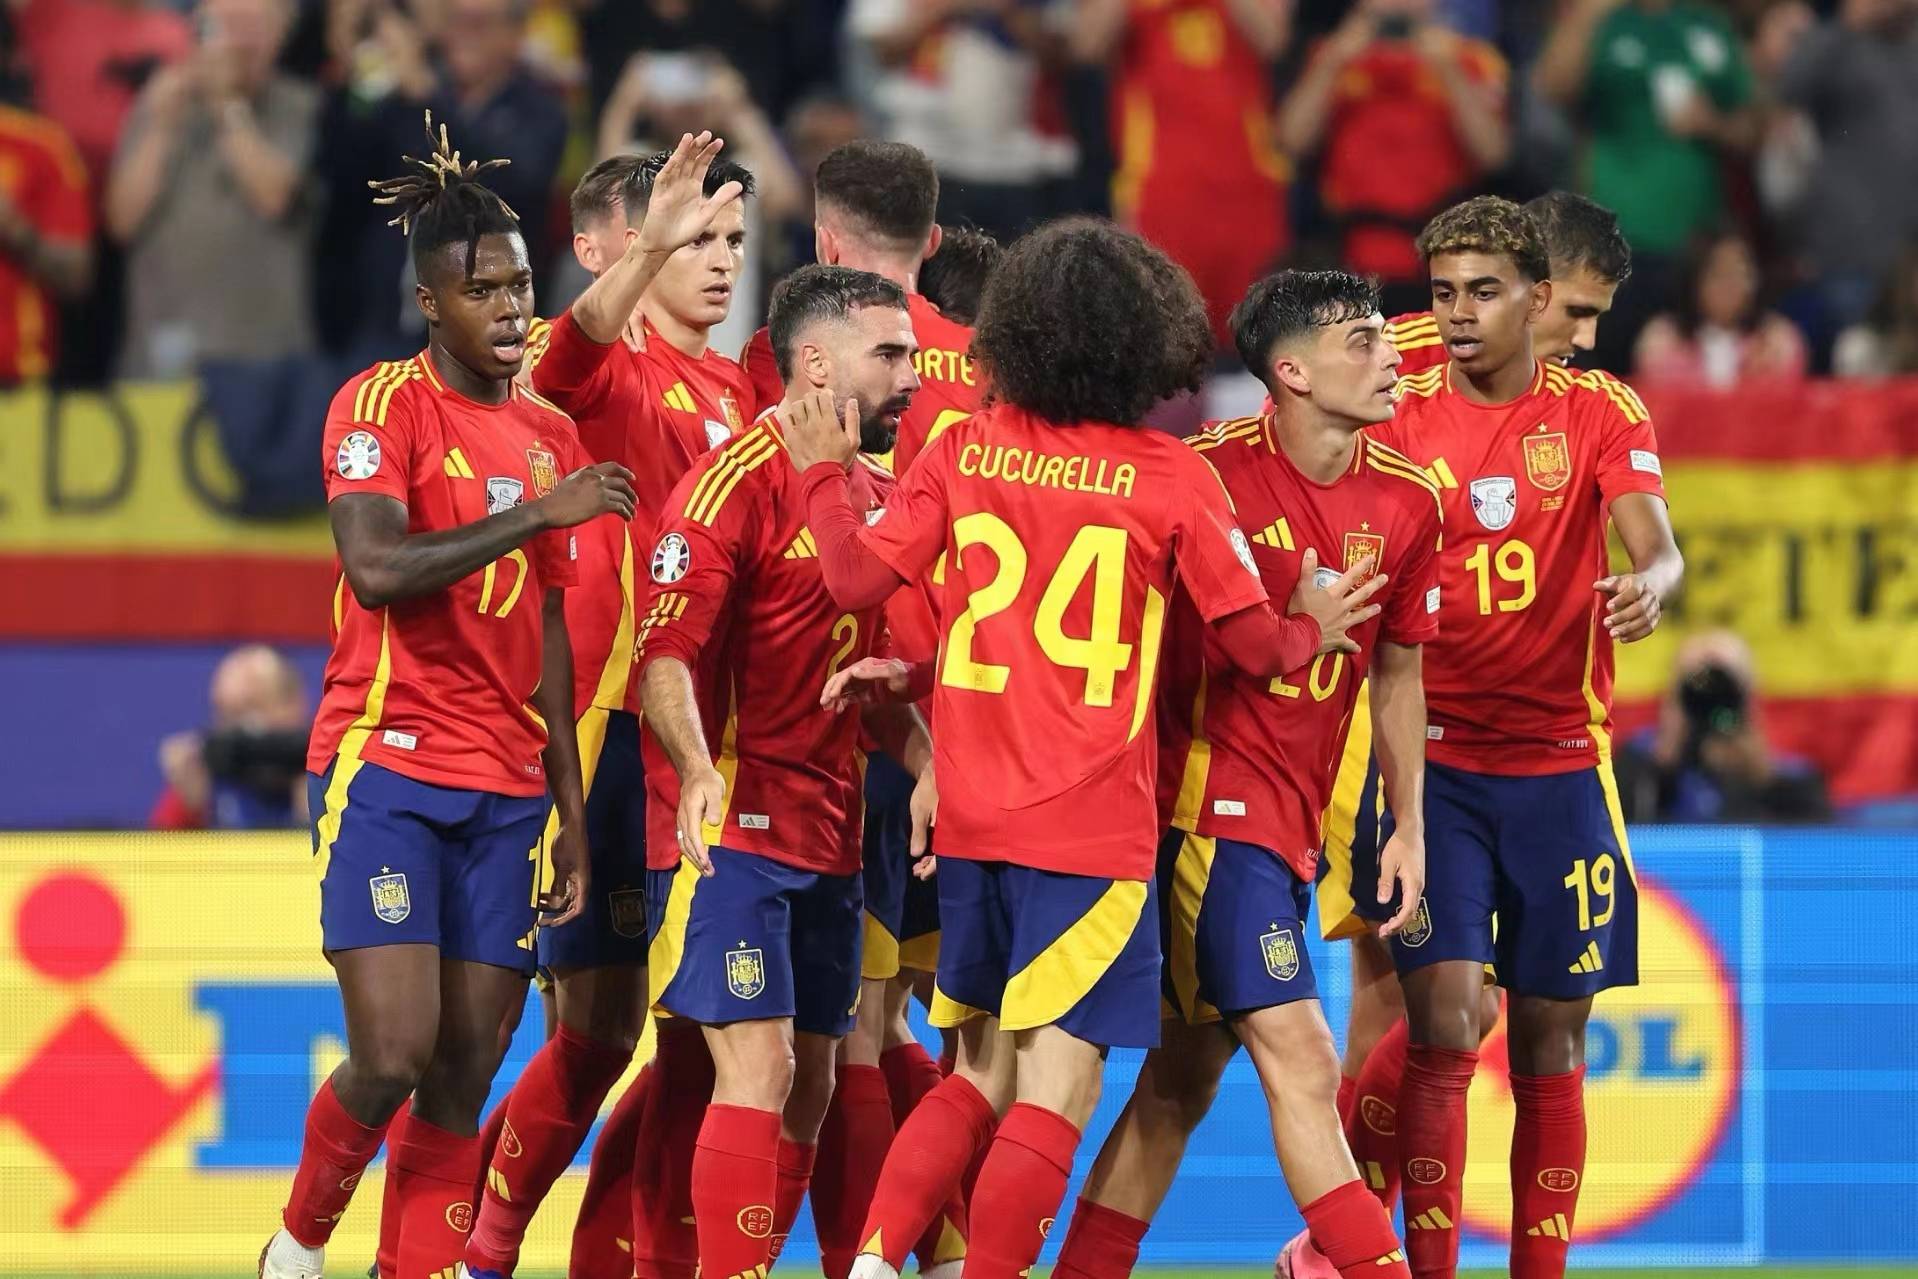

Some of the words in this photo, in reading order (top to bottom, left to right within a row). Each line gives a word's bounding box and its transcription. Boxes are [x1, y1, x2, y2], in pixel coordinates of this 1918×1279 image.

[958, 443, 1137, 499] CUCURELLA
[941, 511, 1133, 708] 24
[1465, 539, 1536, 616] 19
[826, 613, 859, 681] 2
[1564, 852, 1616, 932] 19
[747, 1221, 768, 1231] EF
[748, 1212, 770, 1221] RF
